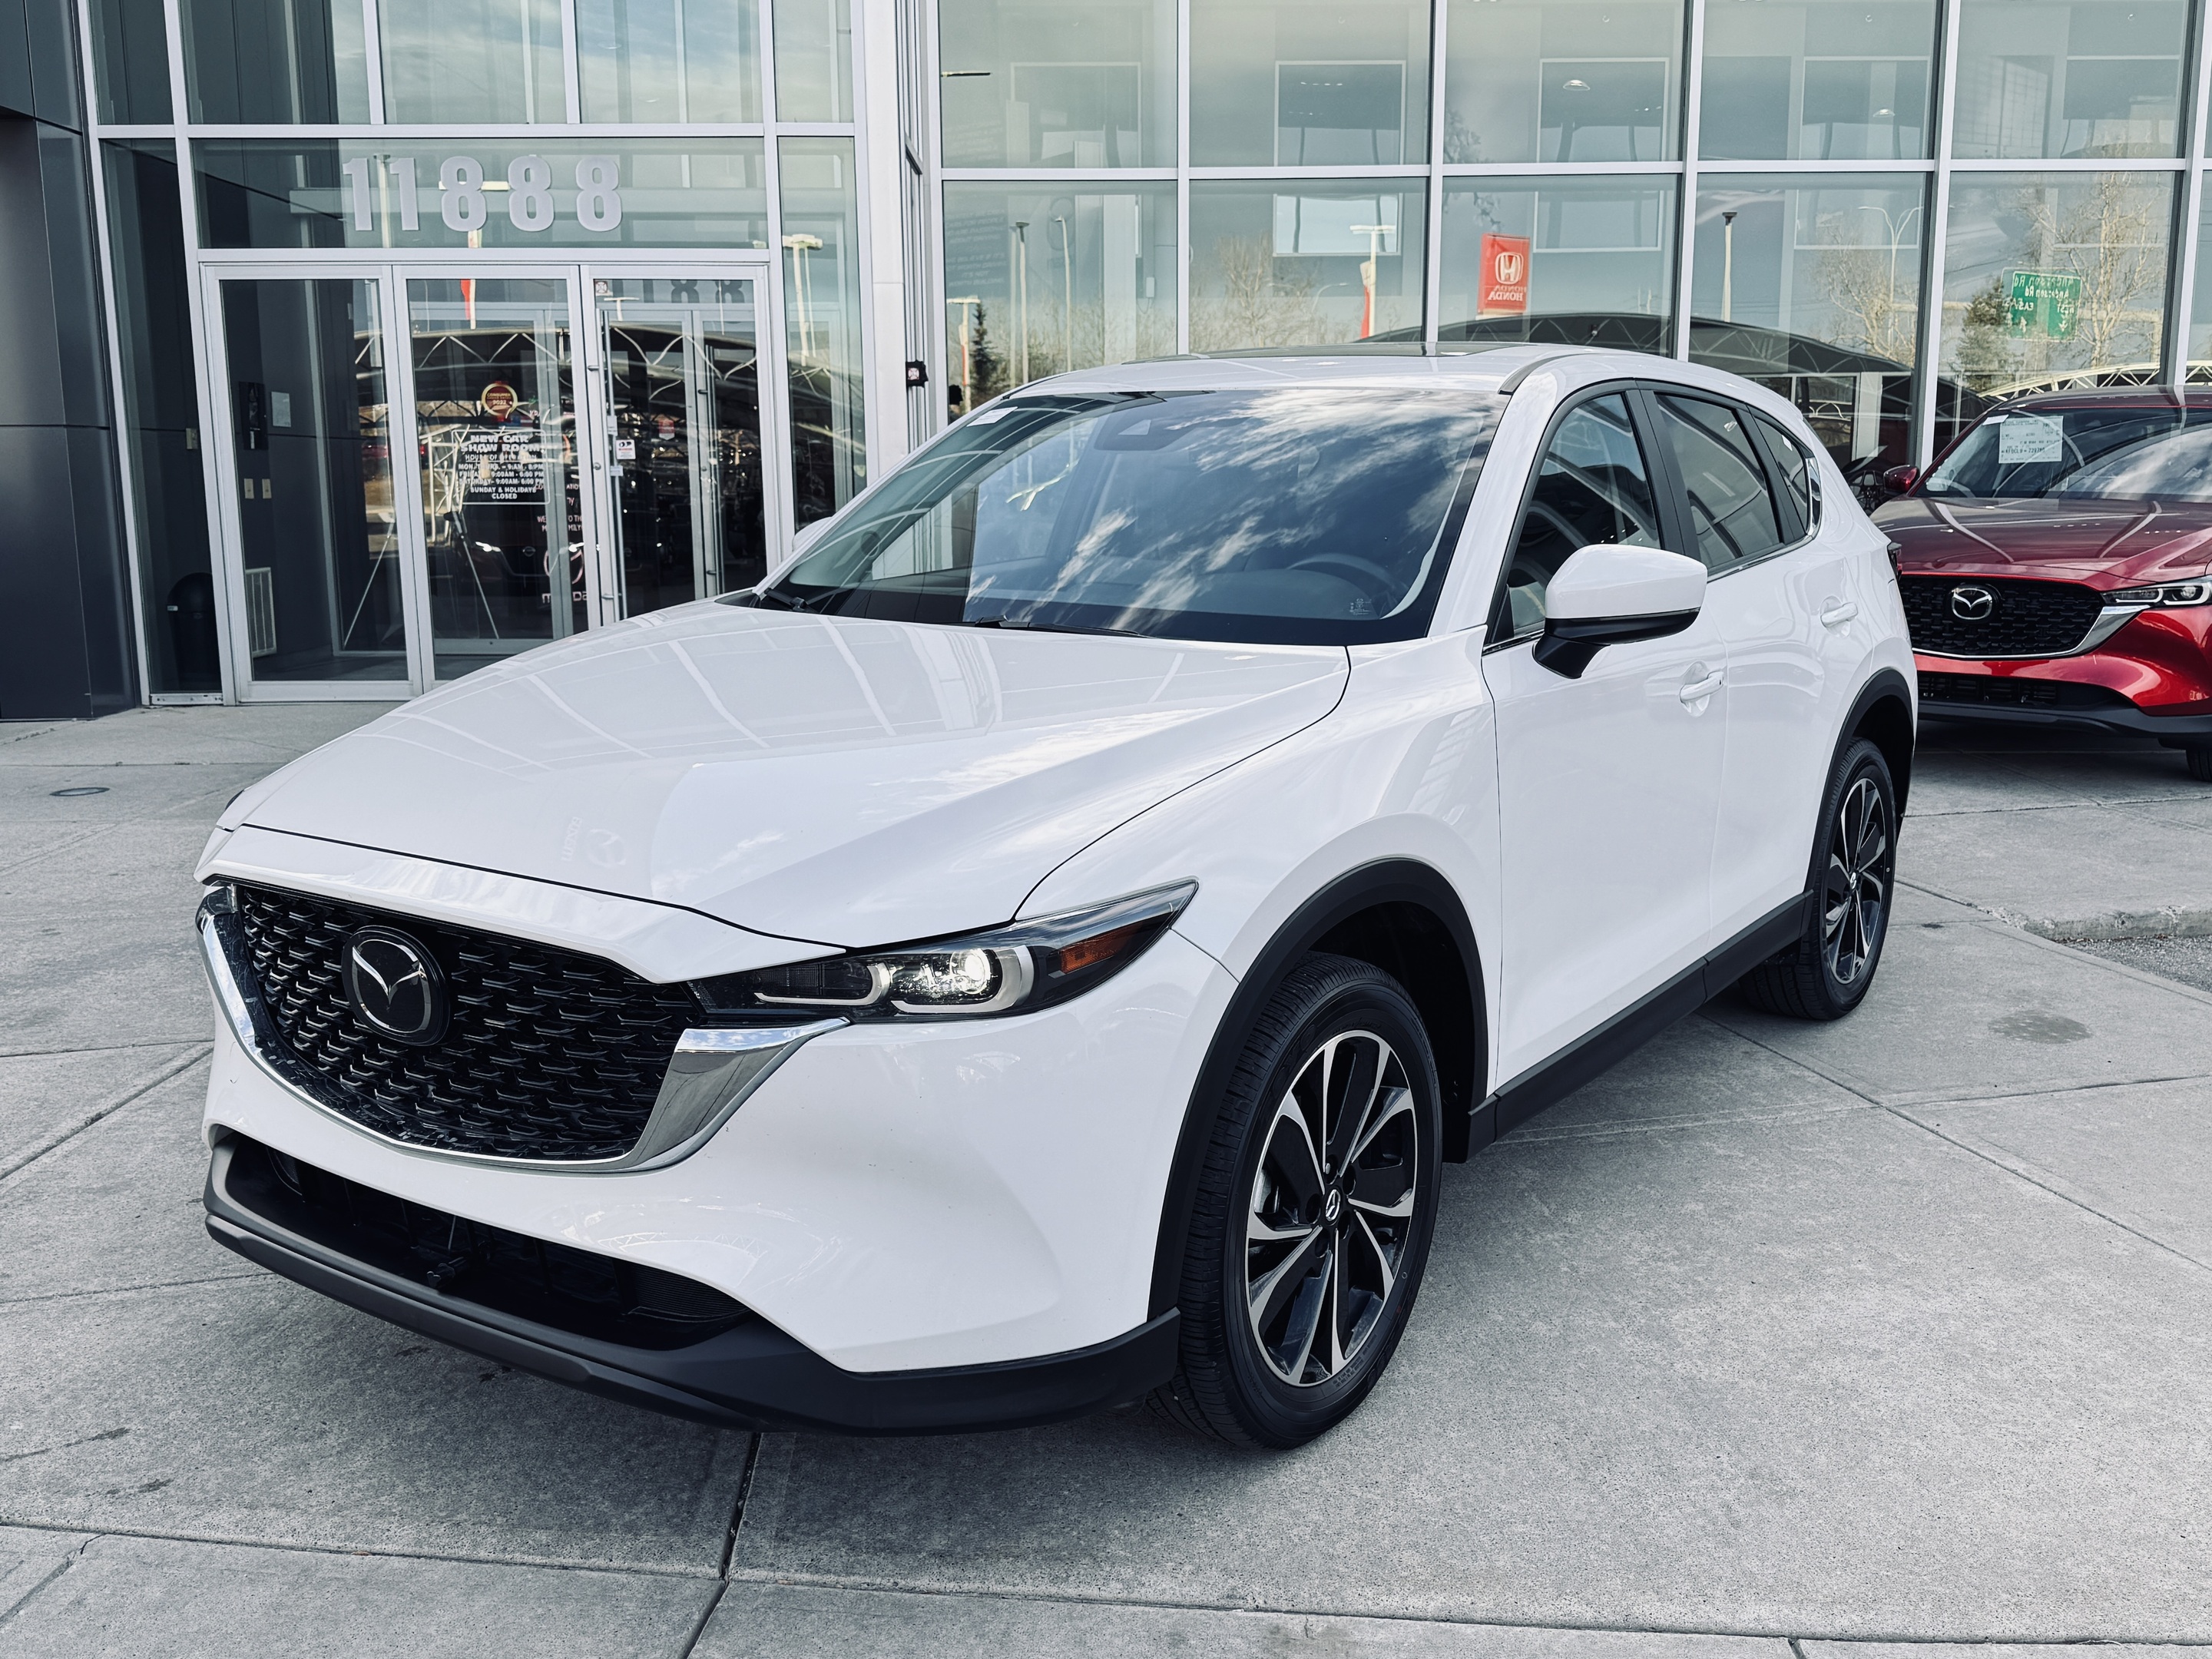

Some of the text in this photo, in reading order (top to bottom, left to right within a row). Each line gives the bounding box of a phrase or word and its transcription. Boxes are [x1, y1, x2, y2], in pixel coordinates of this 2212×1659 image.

[343, 155, 623, 232] 11888
[471, 435, 529, 443] NEW CAR
[461, 443, 498, 452] SHOW
